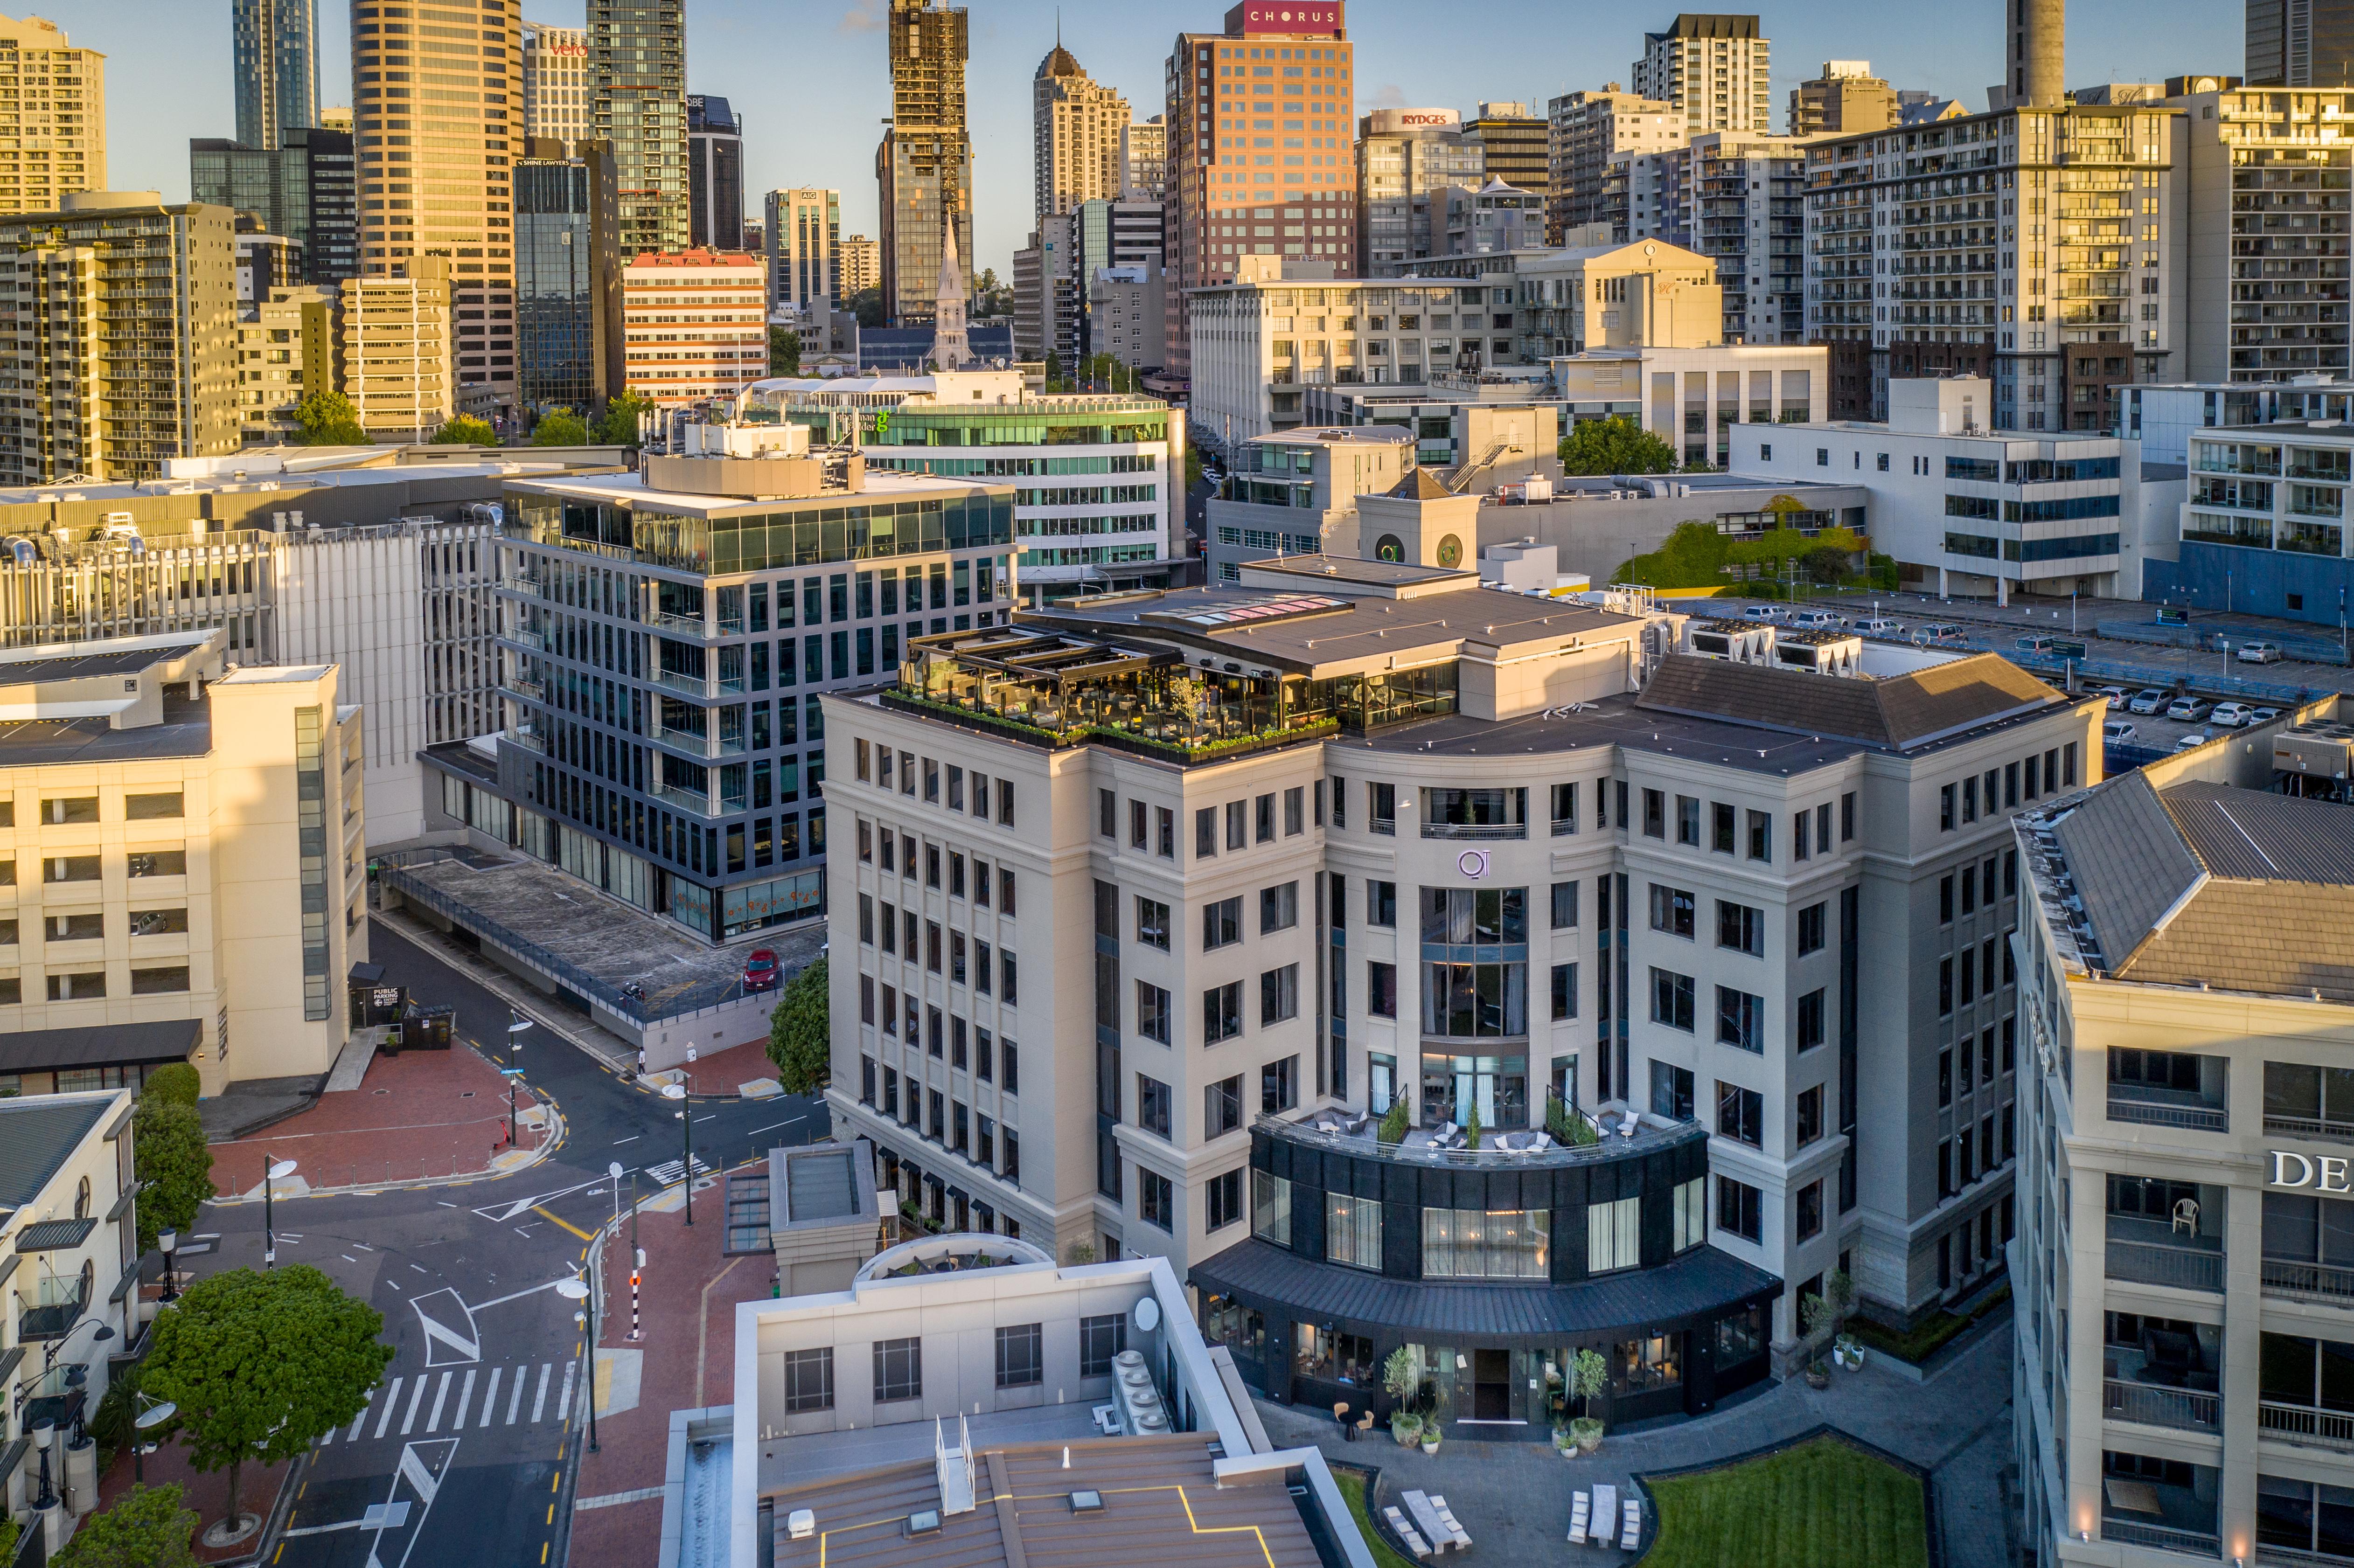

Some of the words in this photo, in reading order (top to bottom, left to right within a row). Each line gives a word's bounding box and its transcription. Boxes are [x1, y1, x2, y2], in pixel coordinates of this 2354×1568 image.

[1250, 11, 1334, 22] CHORUS
[550, 44, 588, 56] vero
[687, 98, 703, 107] QBE
[1401, 115, 1446, 124] RYDGES
[1458, 851, 1491, 880] QT
[2270, 1151, 2354, 1193] DE
